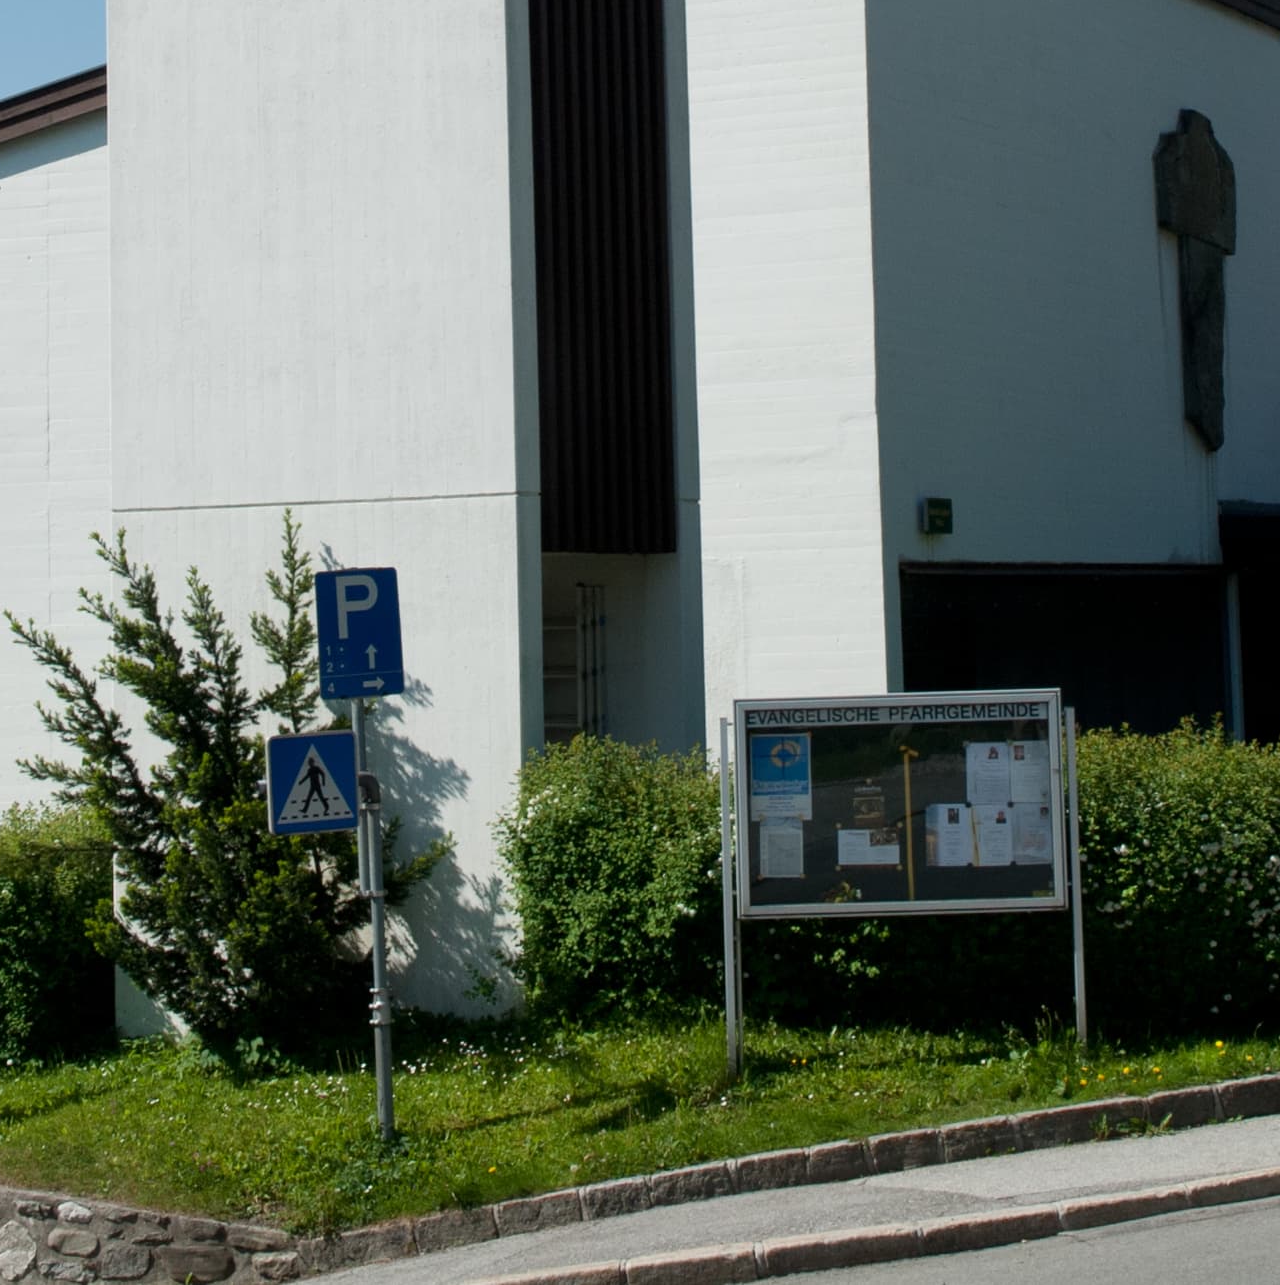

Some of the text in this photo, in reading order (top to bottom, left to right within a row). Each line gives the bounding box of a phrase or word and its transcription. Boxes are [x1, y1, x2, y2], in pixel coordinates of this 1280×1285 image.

[335, 575, 378, 640] P
[326, 646, 331, 656] 1
[326, 662, 333, 673] 2
[328, 682, 335, 693] 4
[747, 704, 1040, 724] EVANGELISCHE PFARRGEMEINDE
